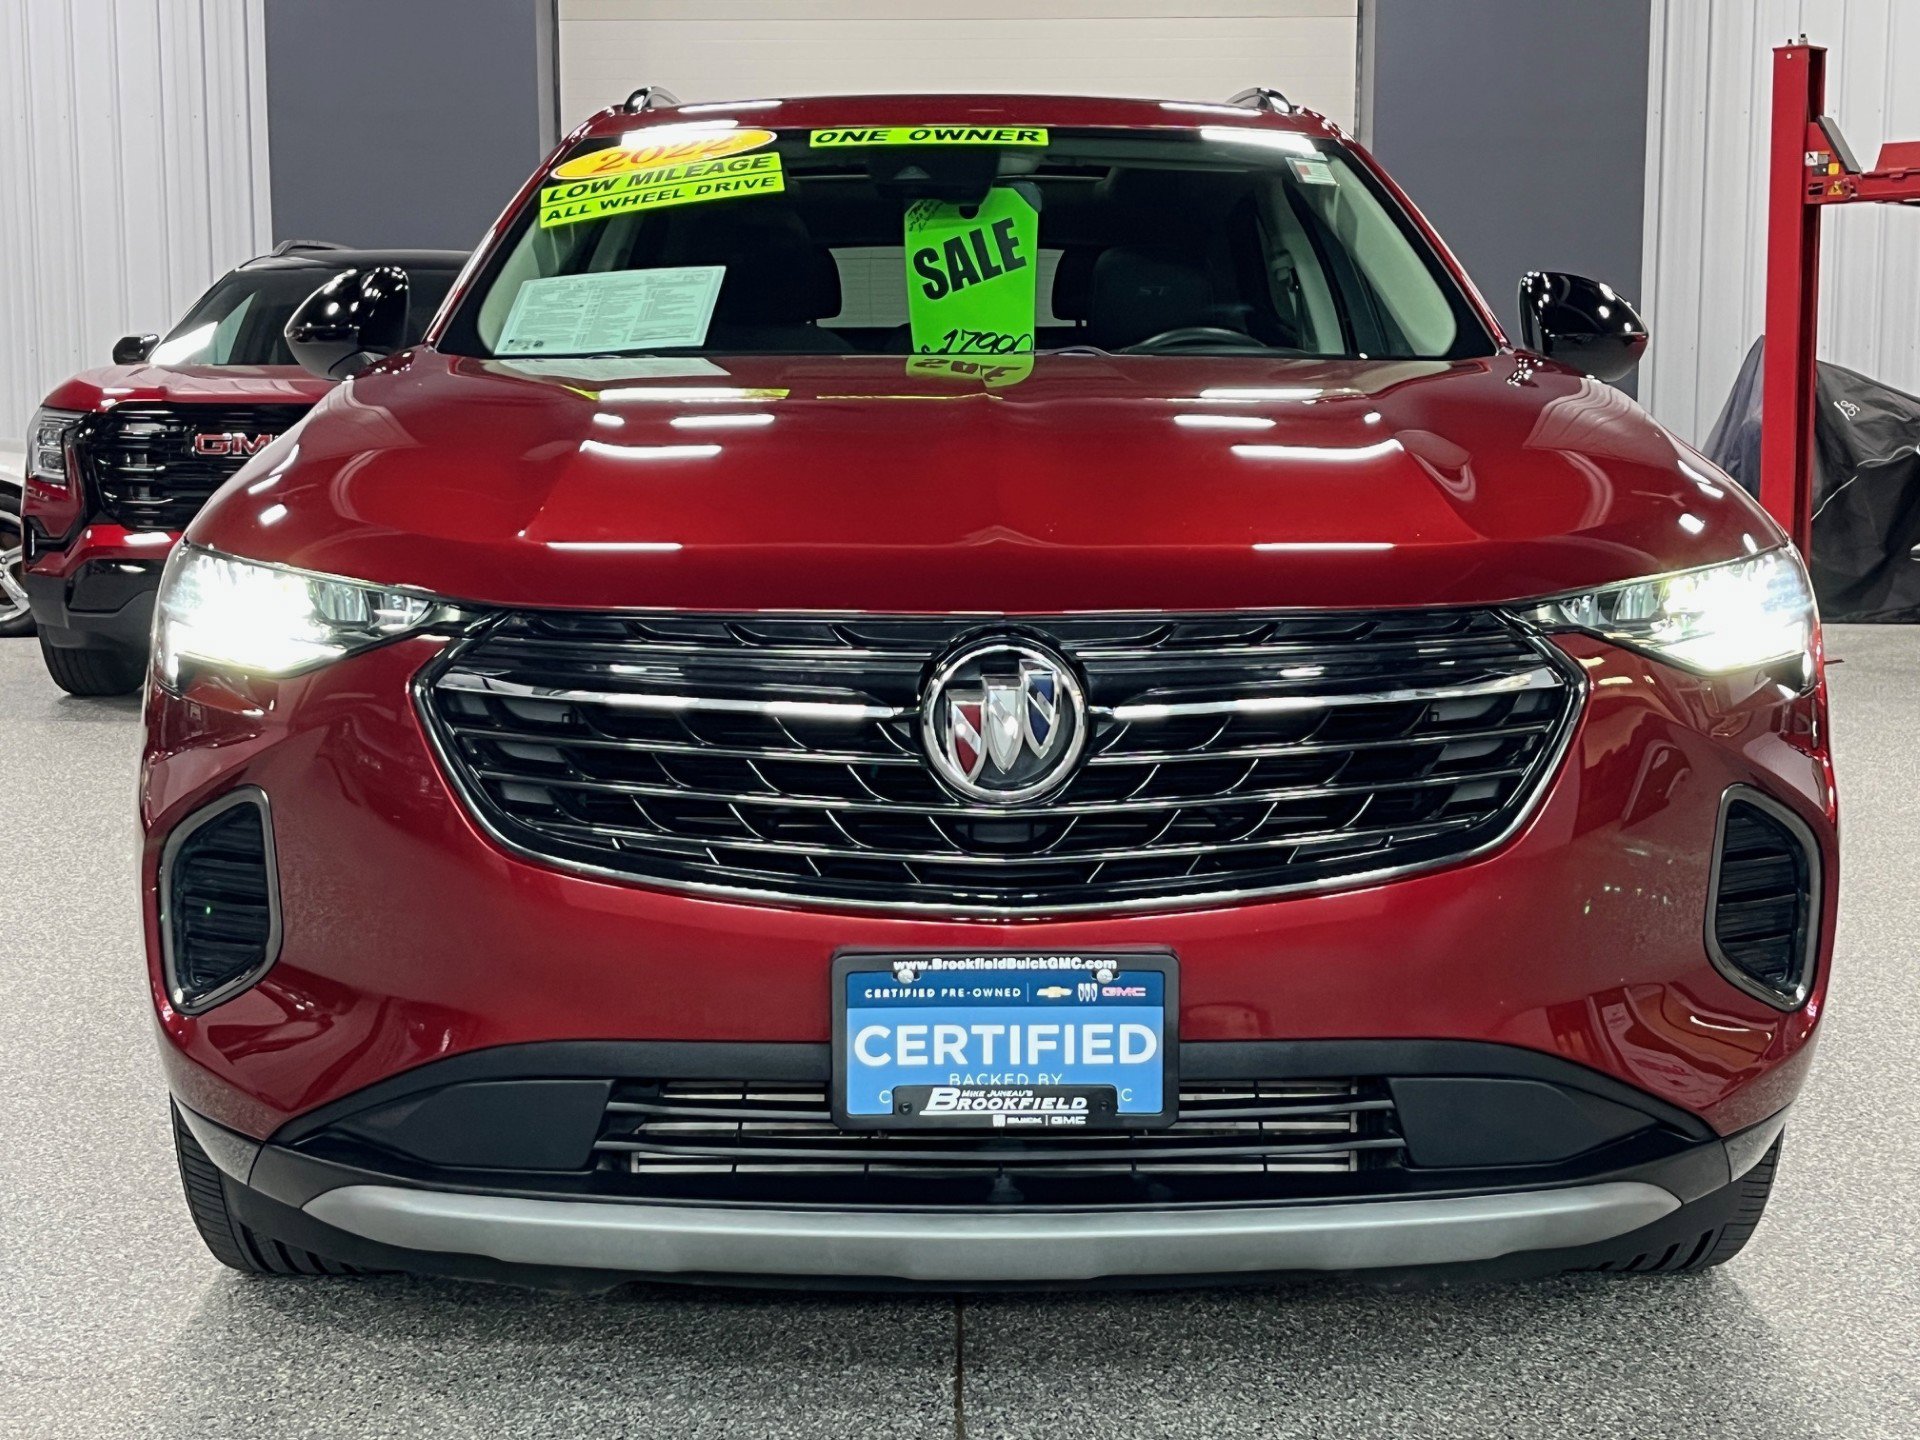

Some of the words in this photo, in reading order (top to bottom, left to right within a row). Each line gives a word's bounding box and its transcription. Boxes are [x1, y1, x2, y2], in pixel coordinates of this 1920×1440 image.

[815, 130, 891, 144] ONE
[908, 129, 1040, 143] OWNER
[593, 136, 735, 173] 2022
[547, 177, 619, 203] LOW
[627, 155, 773, 187] MILEAGE
[546, 204, 591, 222] ALL
[600, 188, 686, 210] WHEEL
[695, 176, 776, 196] DRIVE
[913, 217, 1028, 300] SALE
[195, 432, 280, 455] GM
[893, 957, 1118, 971] www.BrookfieldBuickGMC.com
[865, 988, 936, 999] CERTIFIED
[941, 987, 1022, 998] PRE-OWNED
[1102, 987, 1147, 997] GMC
[854, 1023, 1158, 1067] CERTIFIED
[949, 1073, 1029, 1085] BACKED
[1038, 1073, 1063, 1085] BY
[925, 1087, 1088, 1111] BROOKFIELD
[961, 1089, 986, 1097] MIKE
[1051, 1115, 1087, 1125] GMC
